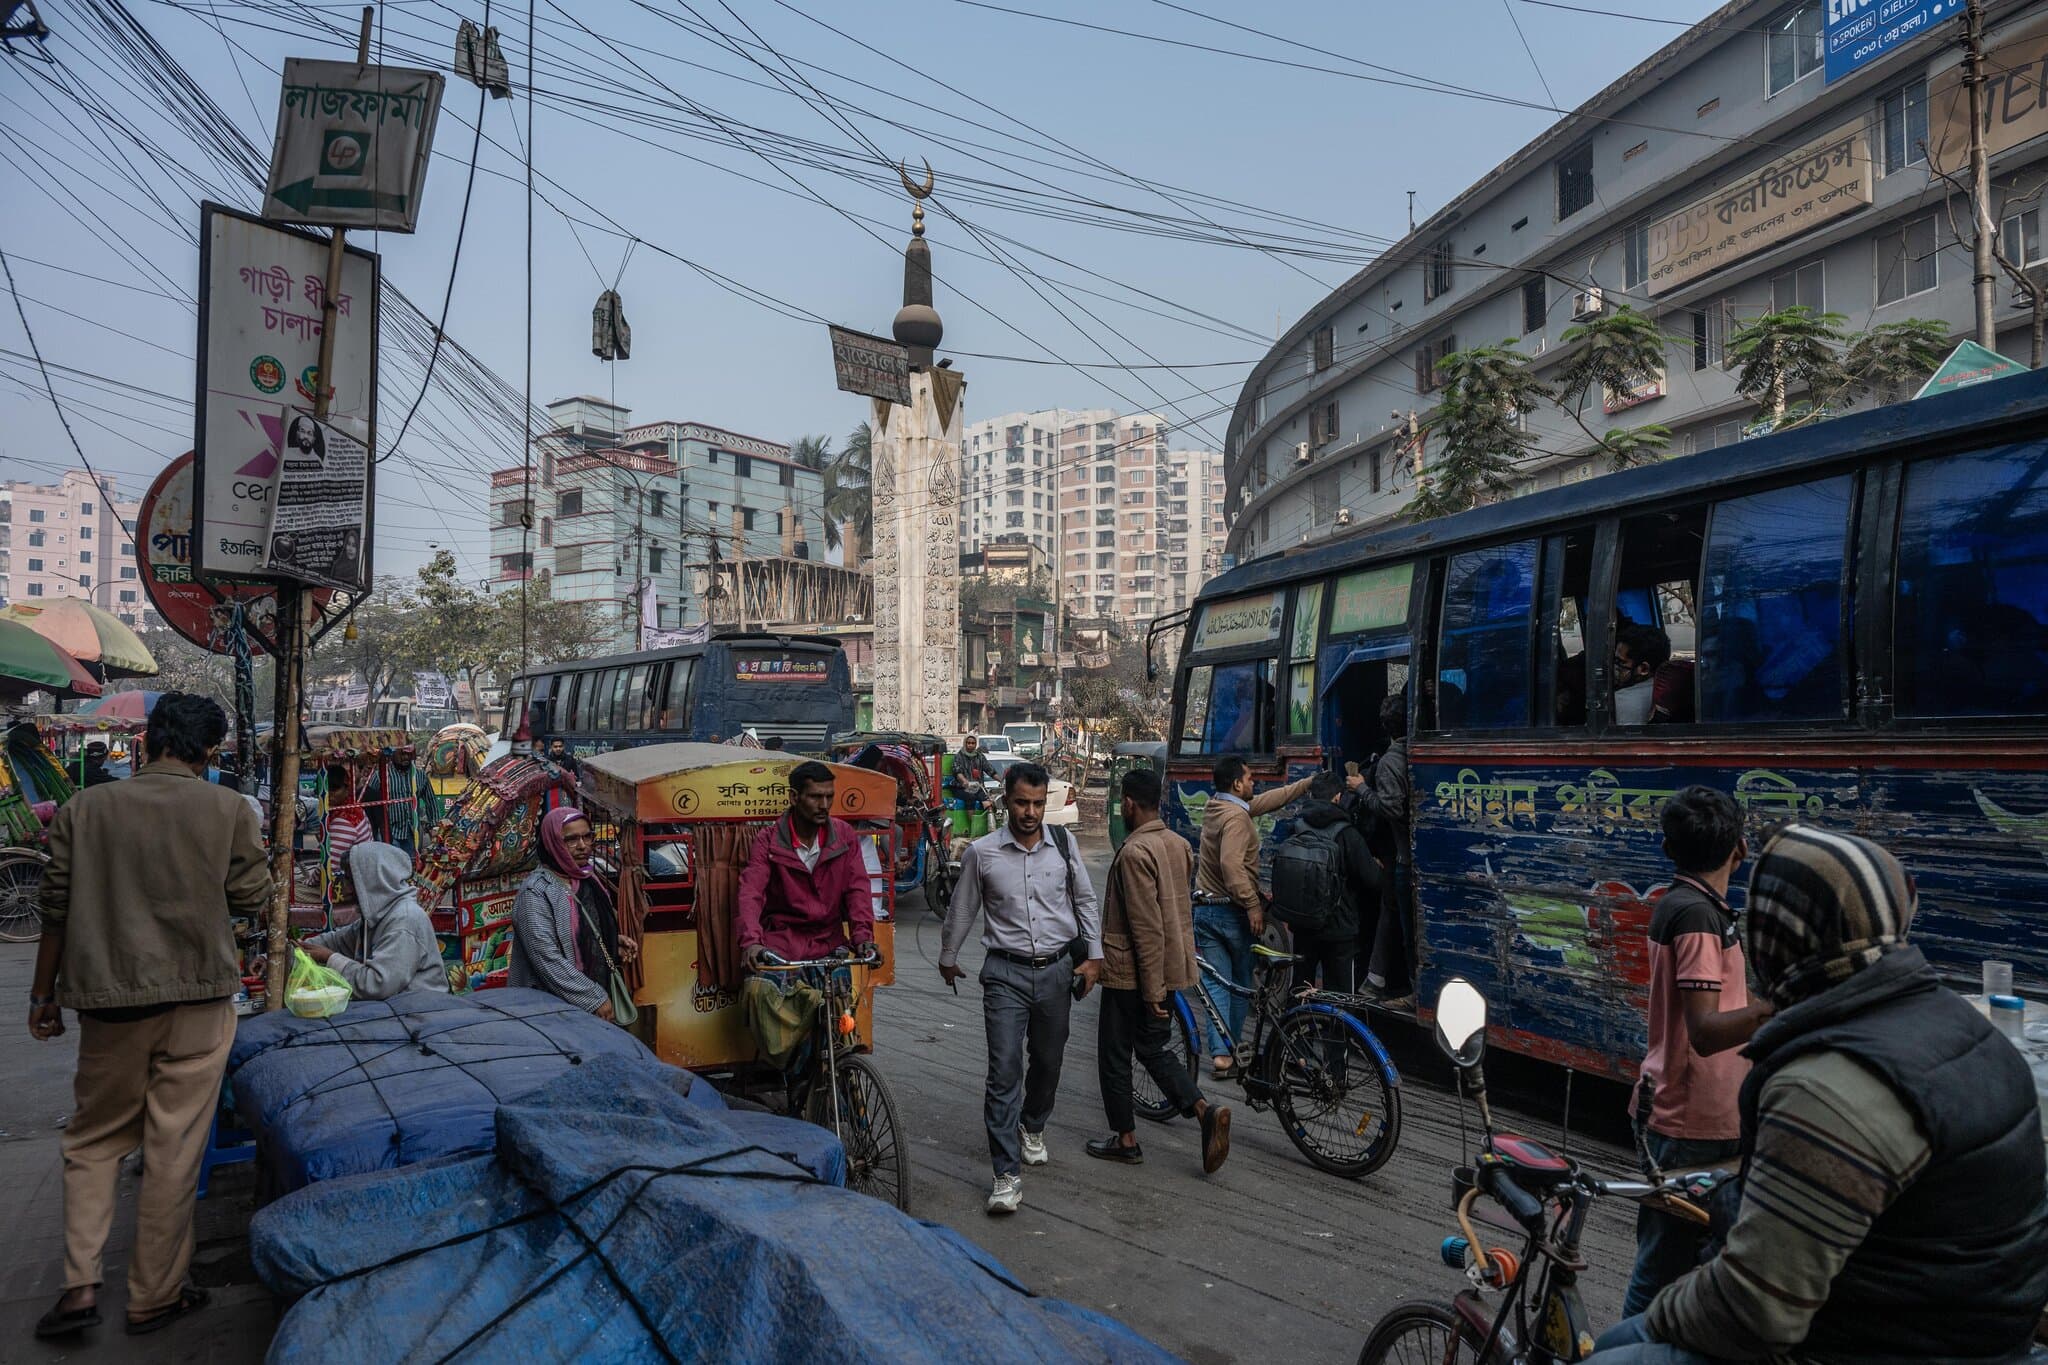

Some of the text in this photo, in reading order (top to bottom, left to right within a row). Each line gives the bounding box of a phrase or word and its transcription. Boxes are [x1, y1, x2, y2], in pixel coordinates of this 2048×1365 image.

[1839, 17, 1873, 44] SPOKEN
[1650, 203, 1711, 267] BCS
[1716, 235, 1737, 252] এই
[717, 783, 791, 798] সুমি পরি
[744, 799, 791, 807] 01721-0
